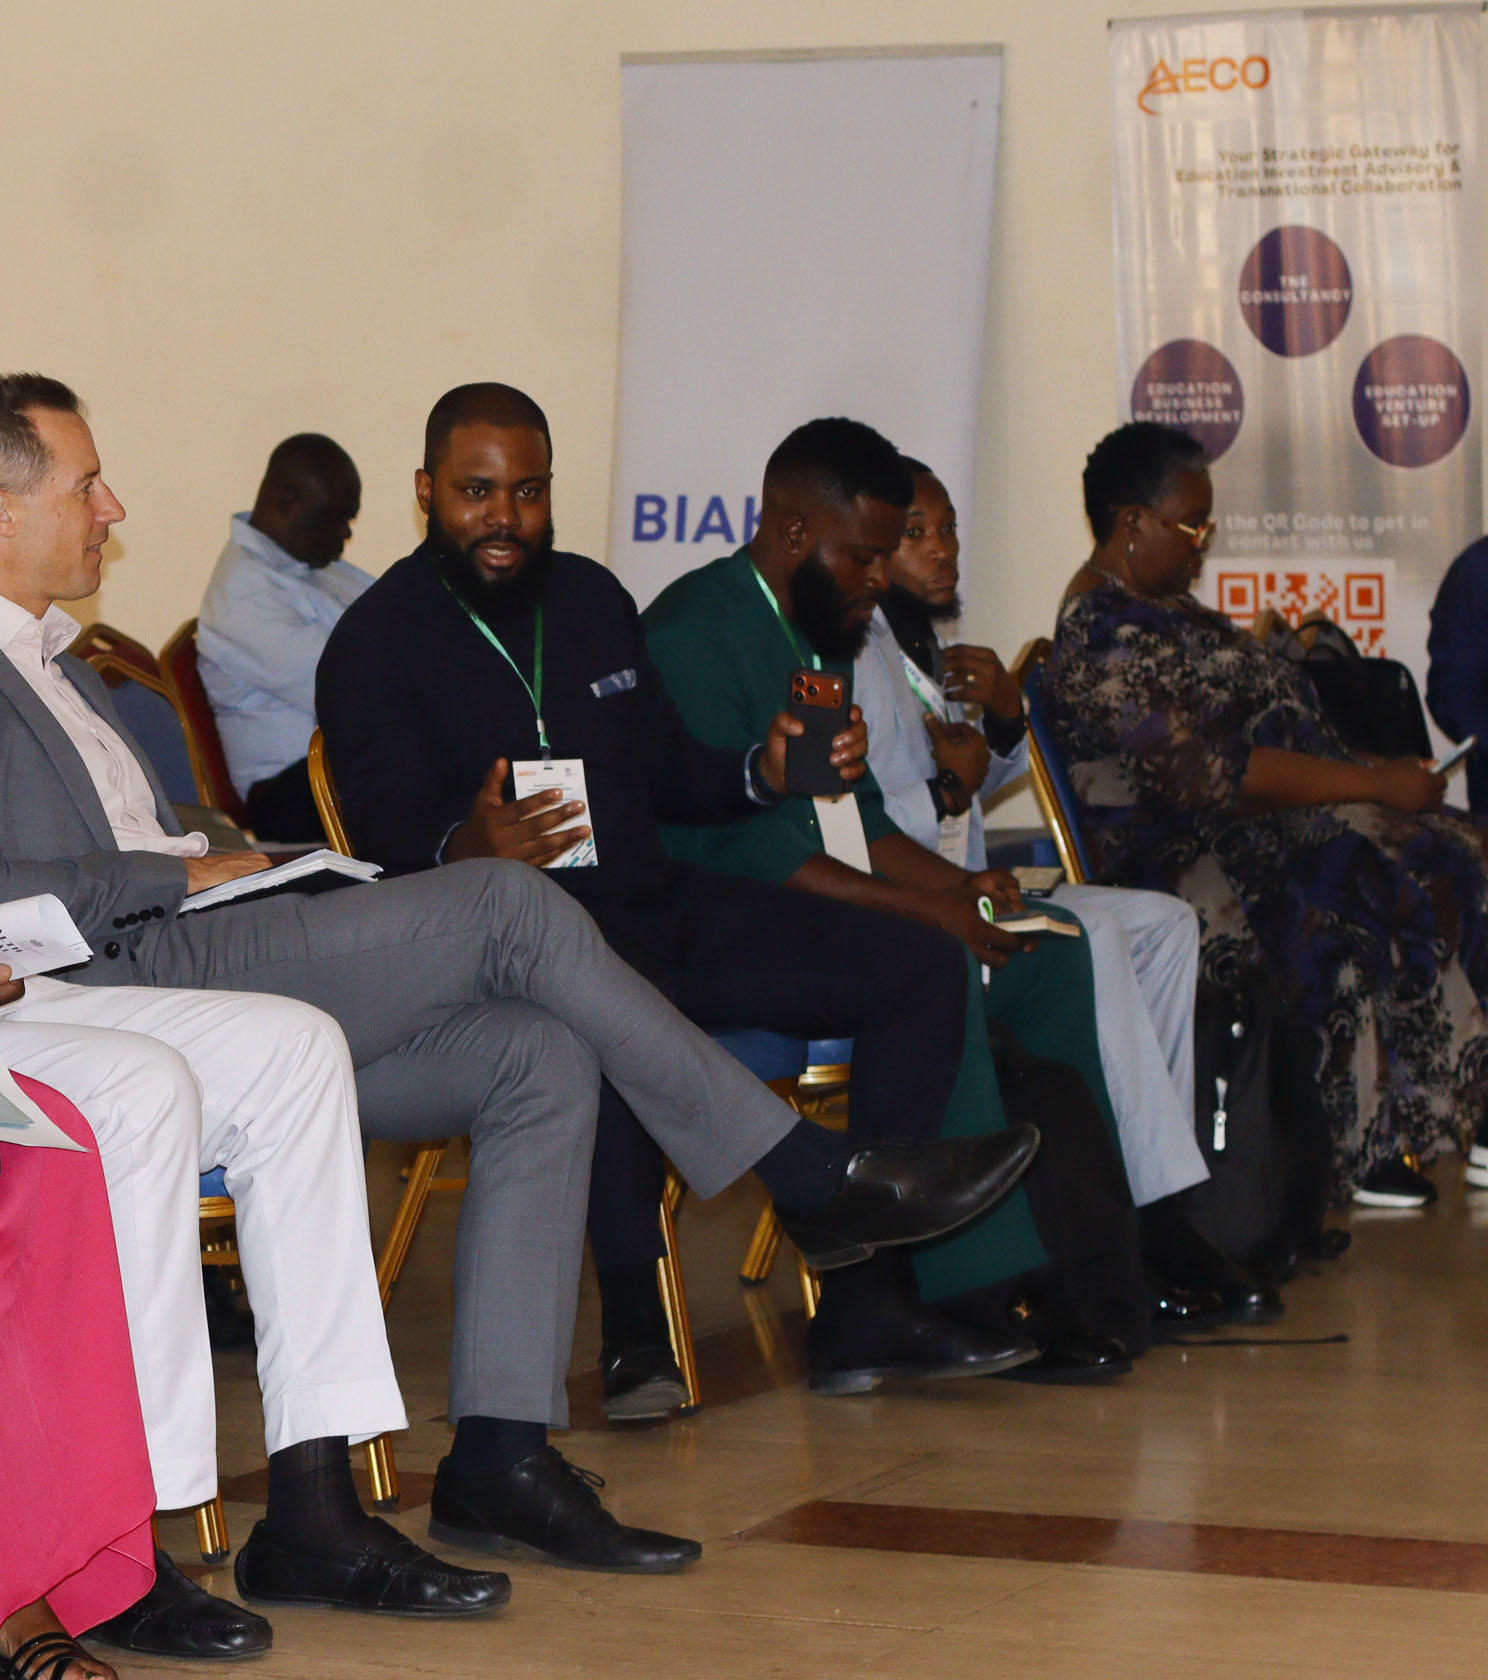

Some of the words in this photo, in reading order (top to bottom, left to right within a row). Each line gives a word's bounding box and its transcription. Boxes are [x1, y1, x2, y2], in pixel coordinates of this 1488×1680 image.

[1138, 55, 1270, 115] AECO
[1218, 150, 1257, 163] Your
[1263, 146, 1344, 162] Strategic
[1350, 143, 1429, 160] Gateway
[1436, 141, 1460, 156] for
[1175, 167, 1260, 184] Education
[1263, 164, 1357, 181] Investment
[1365, 161, 1444, 179] Advisory
[1450, 159, 1461, 173] &
[1217, 183, 1337, 198] Transnational
[1341, 179, 1462, 195] Collaboration
[1147, 381, 1232, 396] EDUCATION
[1365, 384, 1457, 399] EDUCATION
[1375, 398, 1448, 413] VENTURE
[1135, 409, 1241, 424] DEVELOPMENT
[1263, 512, 1288, 532] QR
[1293, 513, 1344, 531] Code
[1349, 514, 1370, 530] to
[1373, 514, 1405, 535] get
